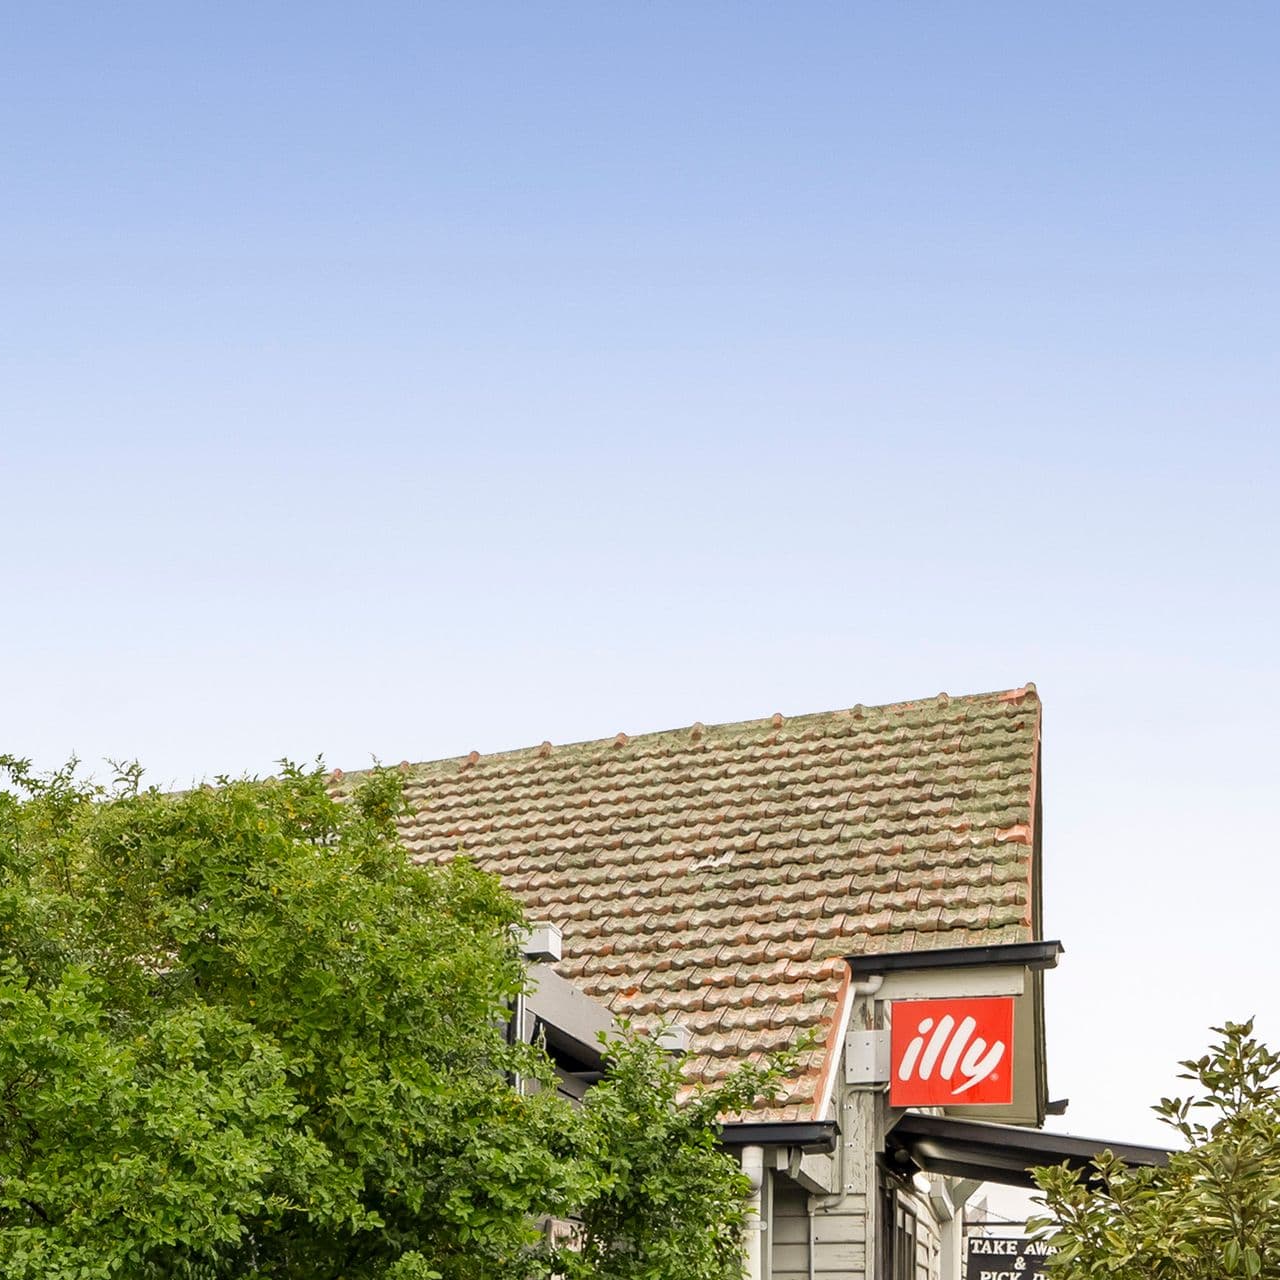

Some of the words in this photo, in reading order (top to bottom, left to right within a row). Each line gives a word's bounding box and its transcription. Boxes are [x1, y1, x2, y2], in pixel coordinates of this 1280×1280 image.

[898, 1014, 1005, 1095] illy
[970, 1239, 1018, 1255] TAKE
[1023, 1241, 1062, 1256] AWA
[1014, 1256, 1027, 1270] &
